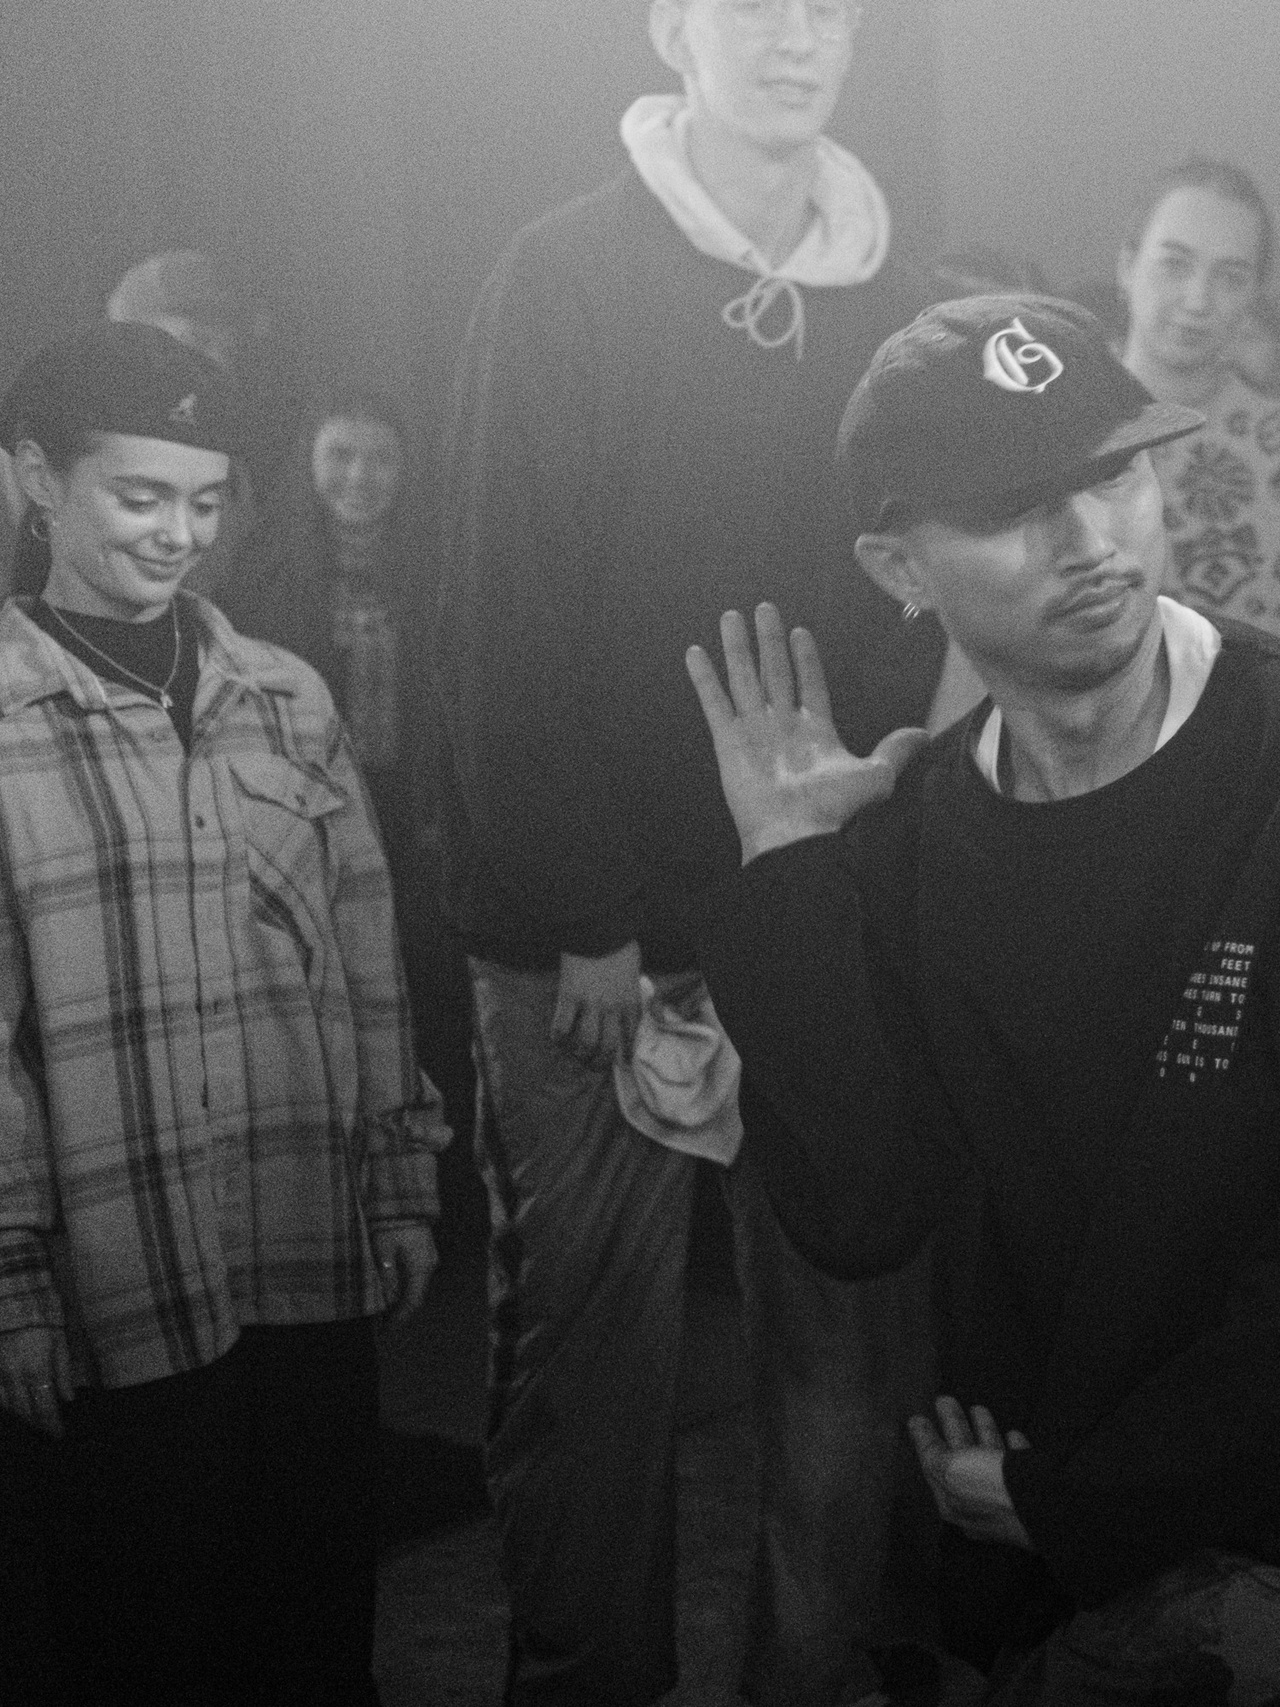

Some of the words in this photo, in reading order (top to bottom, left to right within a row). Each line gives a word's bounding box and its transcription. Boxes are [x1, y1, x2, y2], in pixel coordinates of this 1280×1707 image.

[1224, 941, 1255, 955] FROM
[1221, 958, 1251, 971] FEET
[1209, 974, 1249, 988] INSANE
[1214, 1057, 1230, 1070] TO
